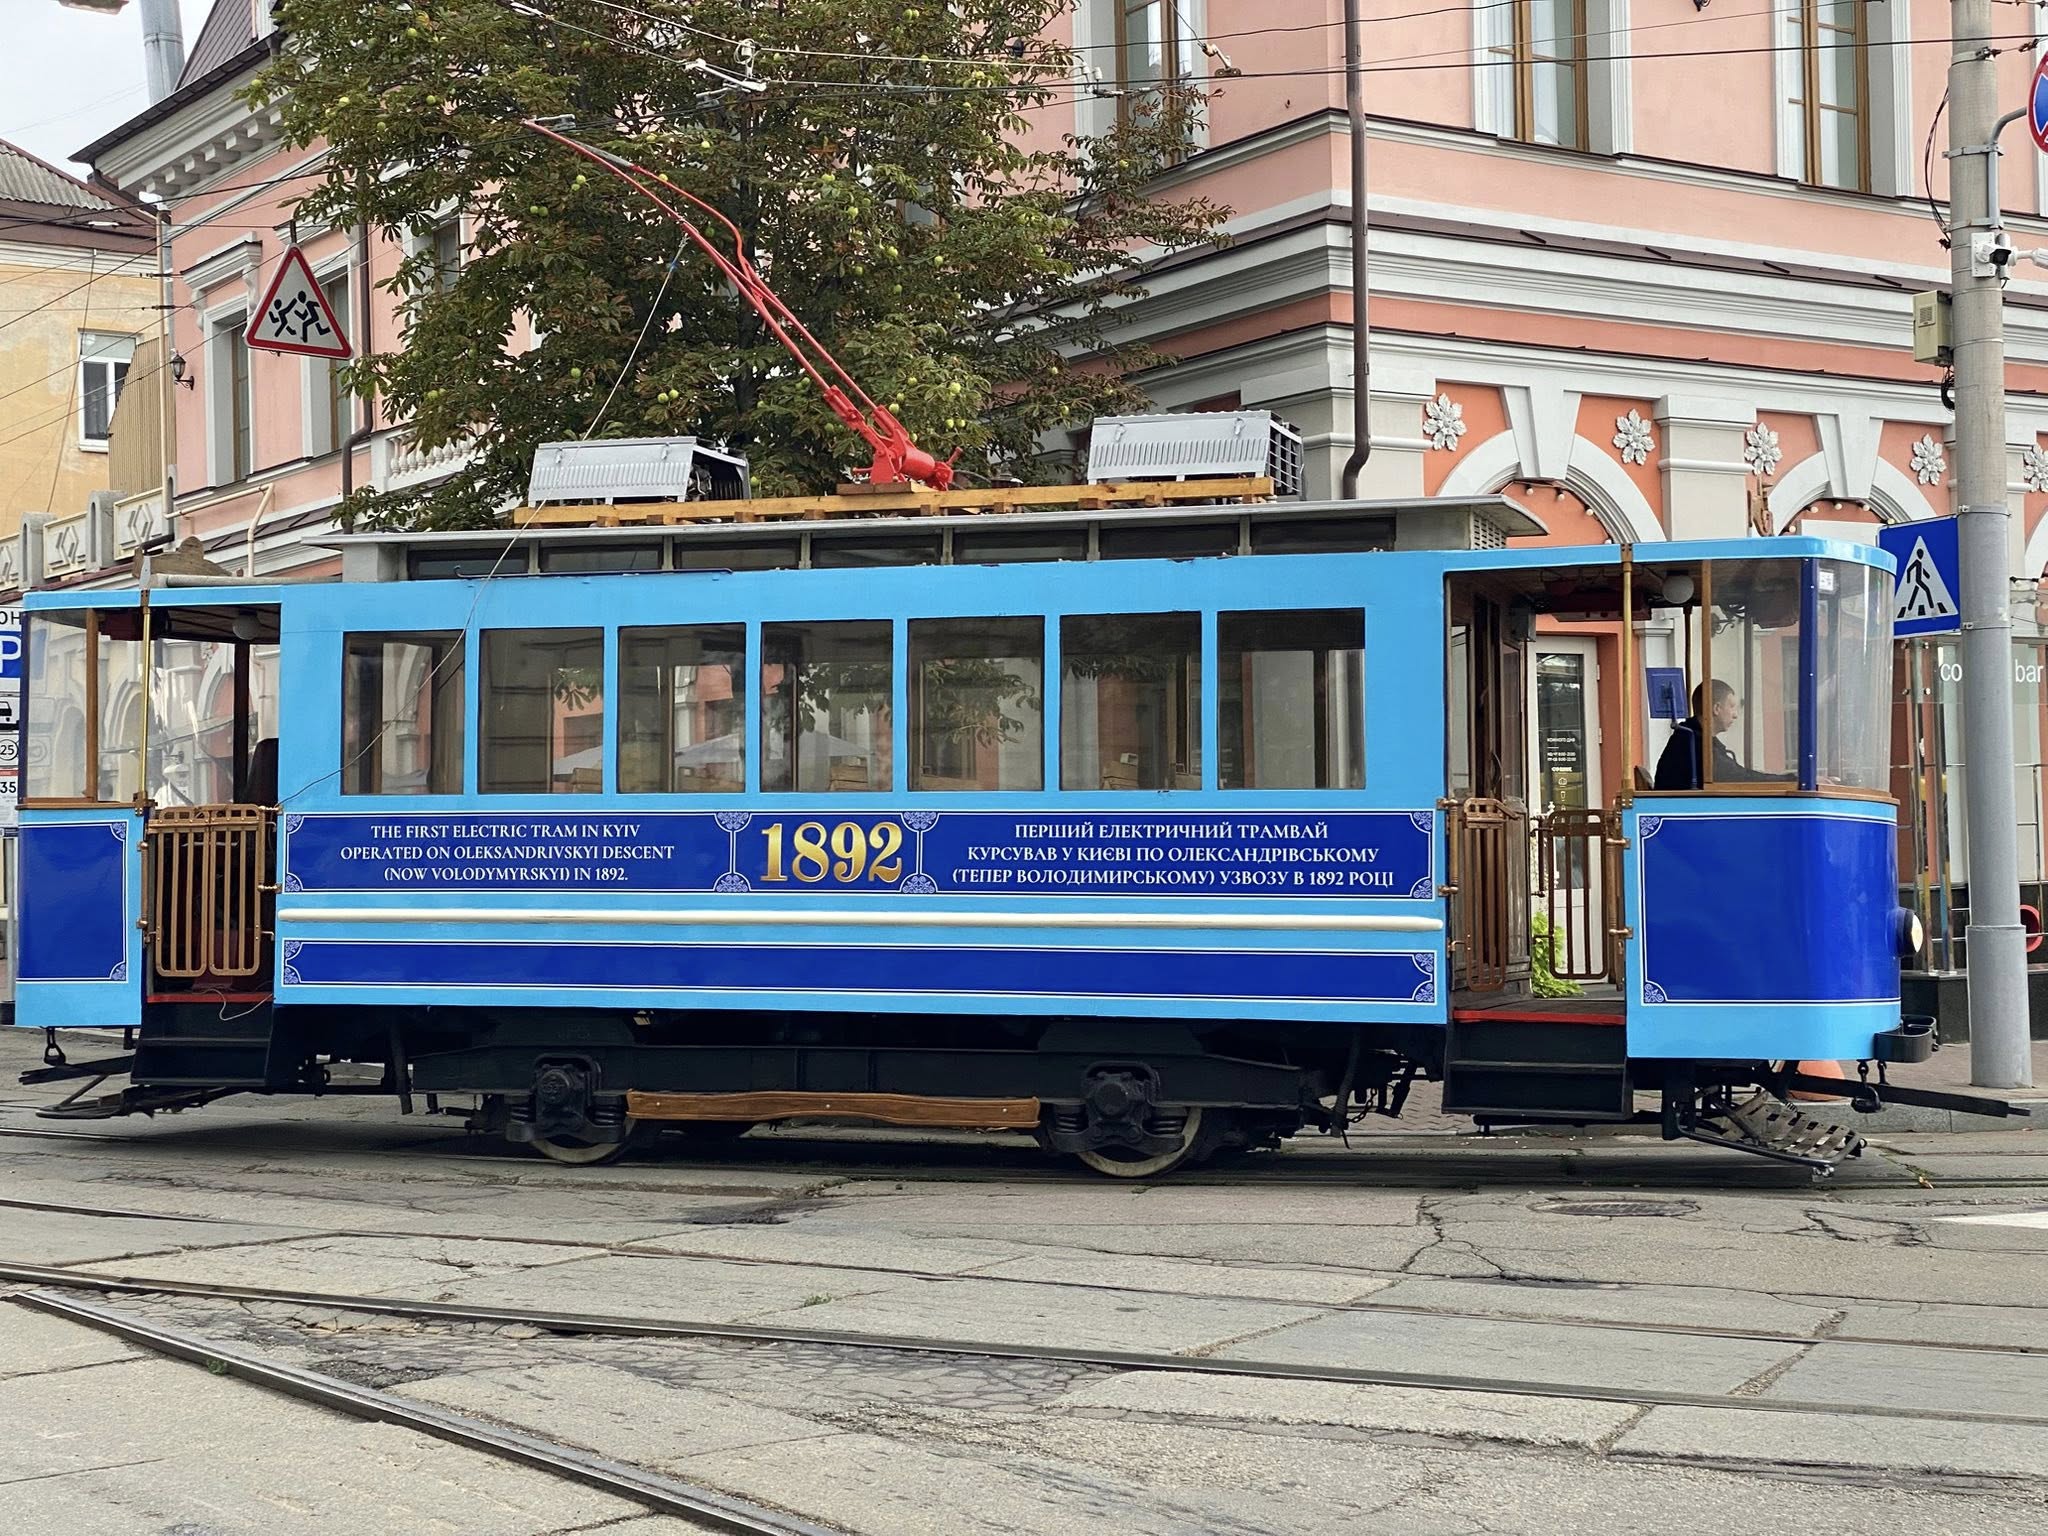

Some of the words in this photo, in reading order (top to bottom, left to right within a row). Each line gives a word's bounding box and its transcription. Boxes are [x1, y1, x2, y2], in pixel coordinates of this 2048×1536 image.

[0, 635, 21, 674] P
[2014, 658, 2044, 683] bar
[370, 825, 402, 839] THE
[406, 824, 450, 839] FIRST
[452, 824, 527, 838] ELECTRIC
[530, 824, 578, 838] TRAM
[581, 824, 599, 838] IN
[602, 824, 641, 838] KYIV
[1015, 821, 1094, 839] ПЕРШИЙ
[1099, 821, 1233, 839] ЕЛЕКТРИЧНИЙ
[1236, 821, 1328, 839] ТРАМВАЙ
[340, 846, 423, 860] OPERATED
[426, 846, 451, 860] ON
[453, 845, 599, 860] OLEKSANDRIVSKYI
[602, 845, 675, 860] DESCENT
[759, 820, 903, 883] 1892
[968, 846, 1058, 861] КУРСУВАВ
[1061, 847, 1074, 861] У
[1077, 846, 1131, 862] КИЄВІ
[1136, 847, 1164, 862] ПО
[1167, 847, 1379, 864] ОЛЕКСАНДРІВСЬКОМУ
[384, 867, 429, 881] (NOW
[431, 867, 570, 881] VOLODYMYRSKYI)
[573, 867, 592, 881] IN
[595, 867, 629, 881] 1892.
[952, 868, 1013, 884] (ТЕПЕР
[1016, 869, 1215, 886] ВОЛОДИМИРСЬКОМУ)
[1219, 870, 1289, 886] УЗВОЗУ
[1293, 871, 1305, 885] В
[1309, 871, 1344, 886] 1892
[1349, 871, 1394, 889] РОЦІ
